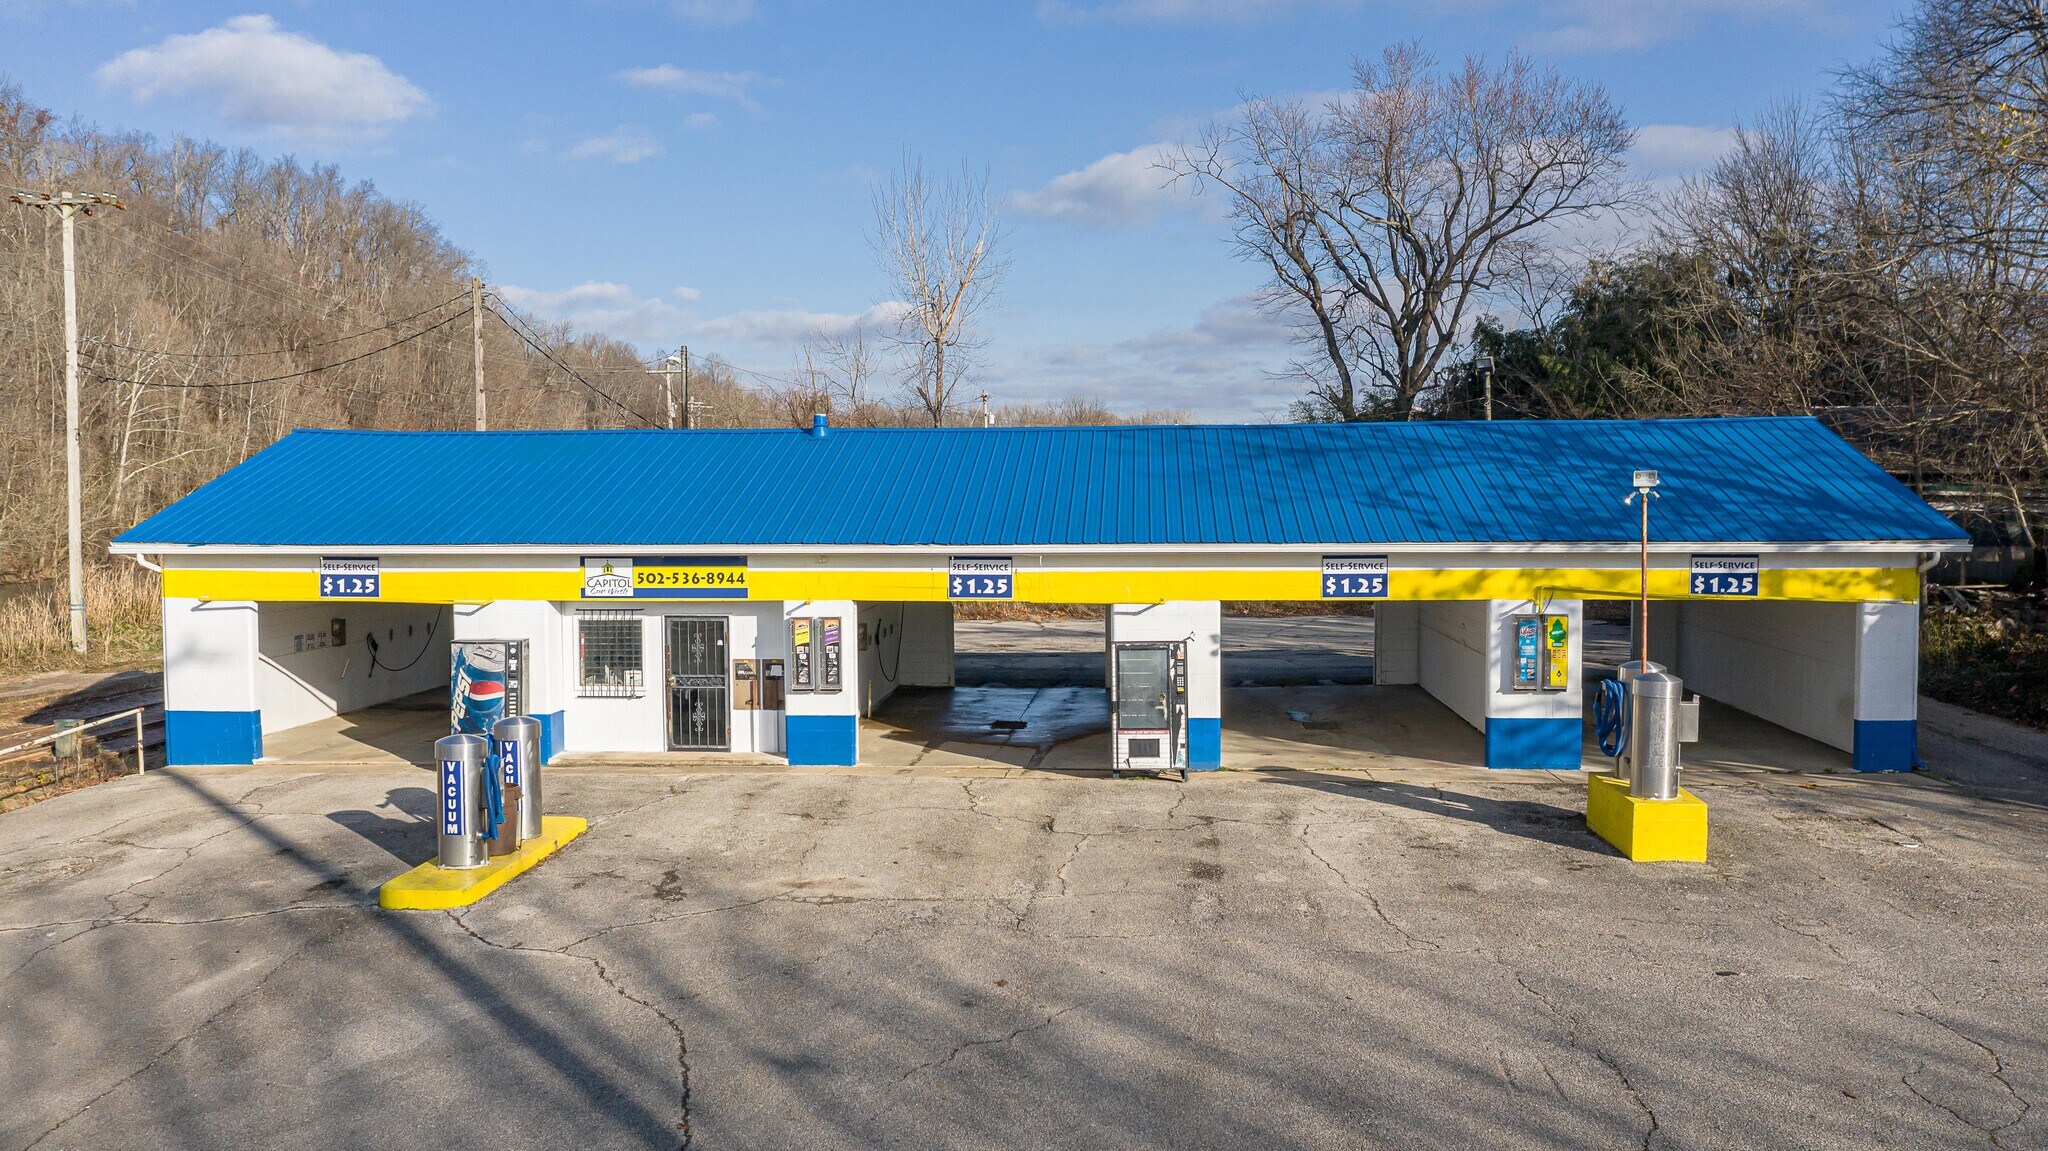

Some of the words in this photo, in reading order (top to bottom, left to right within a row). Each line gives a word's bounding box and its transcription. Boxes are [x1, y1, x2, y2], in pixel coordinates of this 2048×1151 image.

[586, 577, 632, 589] CAPITOL
[637, 572, 746, 585] 502-536-8944
[451, 667, 472, 732] PEPSI
[504, 742, 514, 784] VACU
[446, 761, 458, 834] VACUUM
